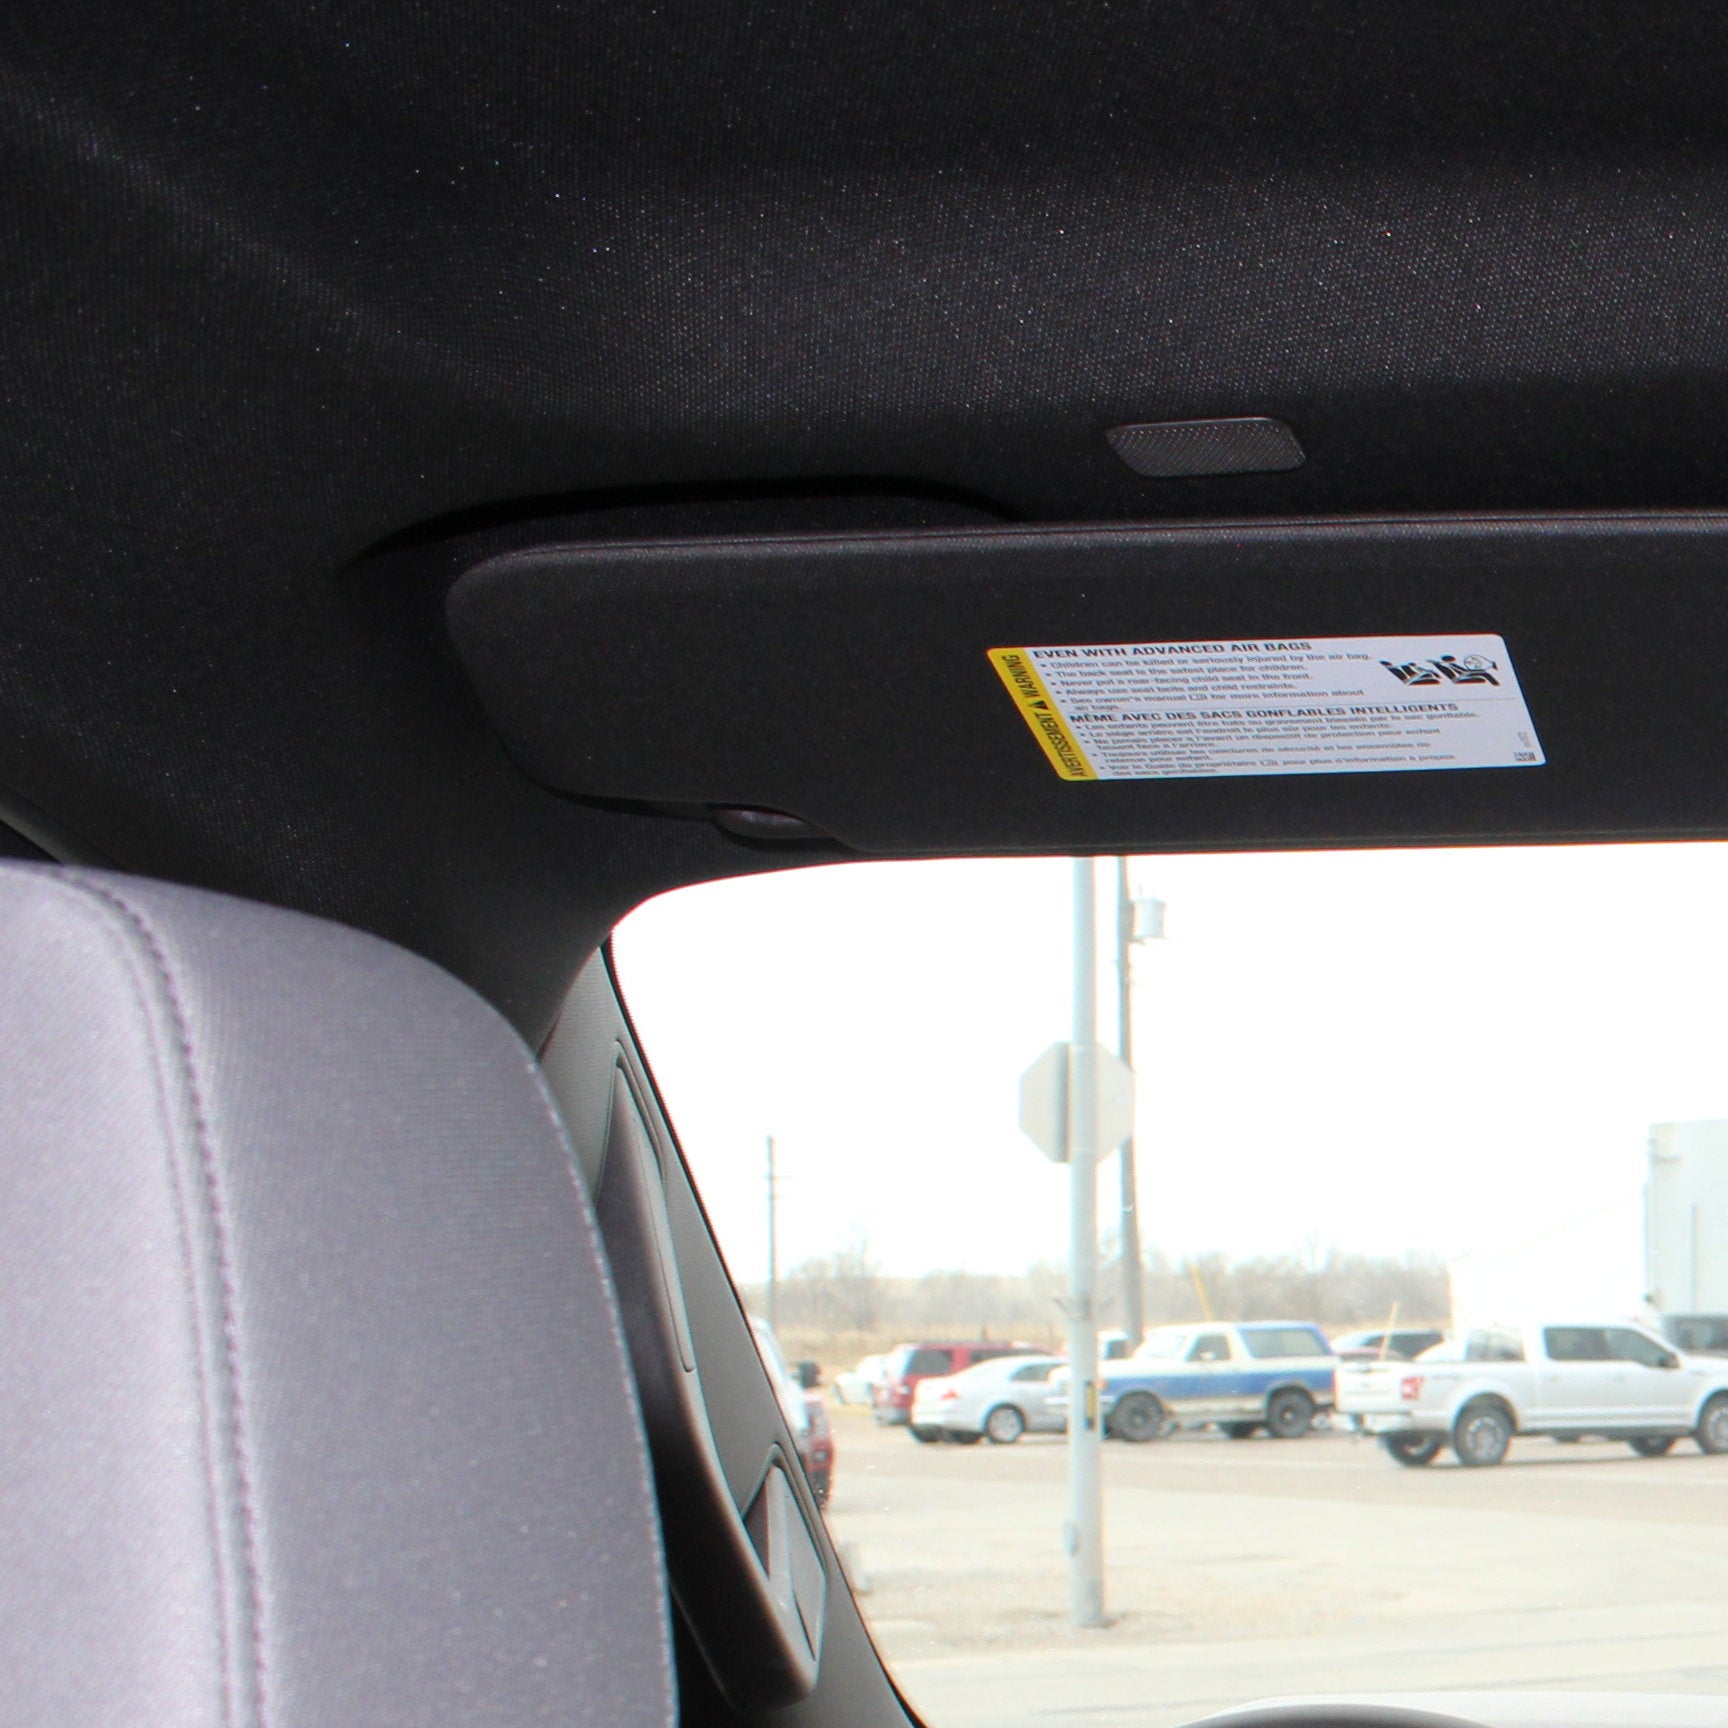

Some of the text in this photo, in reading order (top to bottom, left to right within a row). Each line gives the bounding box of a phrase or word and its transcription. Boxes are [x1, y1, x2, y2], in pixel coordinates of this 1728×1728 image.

[1031, 642, 1312, 658] EVEN WITH ADVANCED AIR BAGS
[1002, 655, 1087, 777] AVERTISSEMENT WARNING
[1070, 713, 1118, 723] MÊME
[1121, 712, 1162, 721] AVEC
[1166, 712, 1196, 720] DES
[1200, 710, 1241, 720] SACS
[1245, 706, 1346, 718] GONFLABLES
[1350, 703, 1459, 714] INTELLIGENTS
